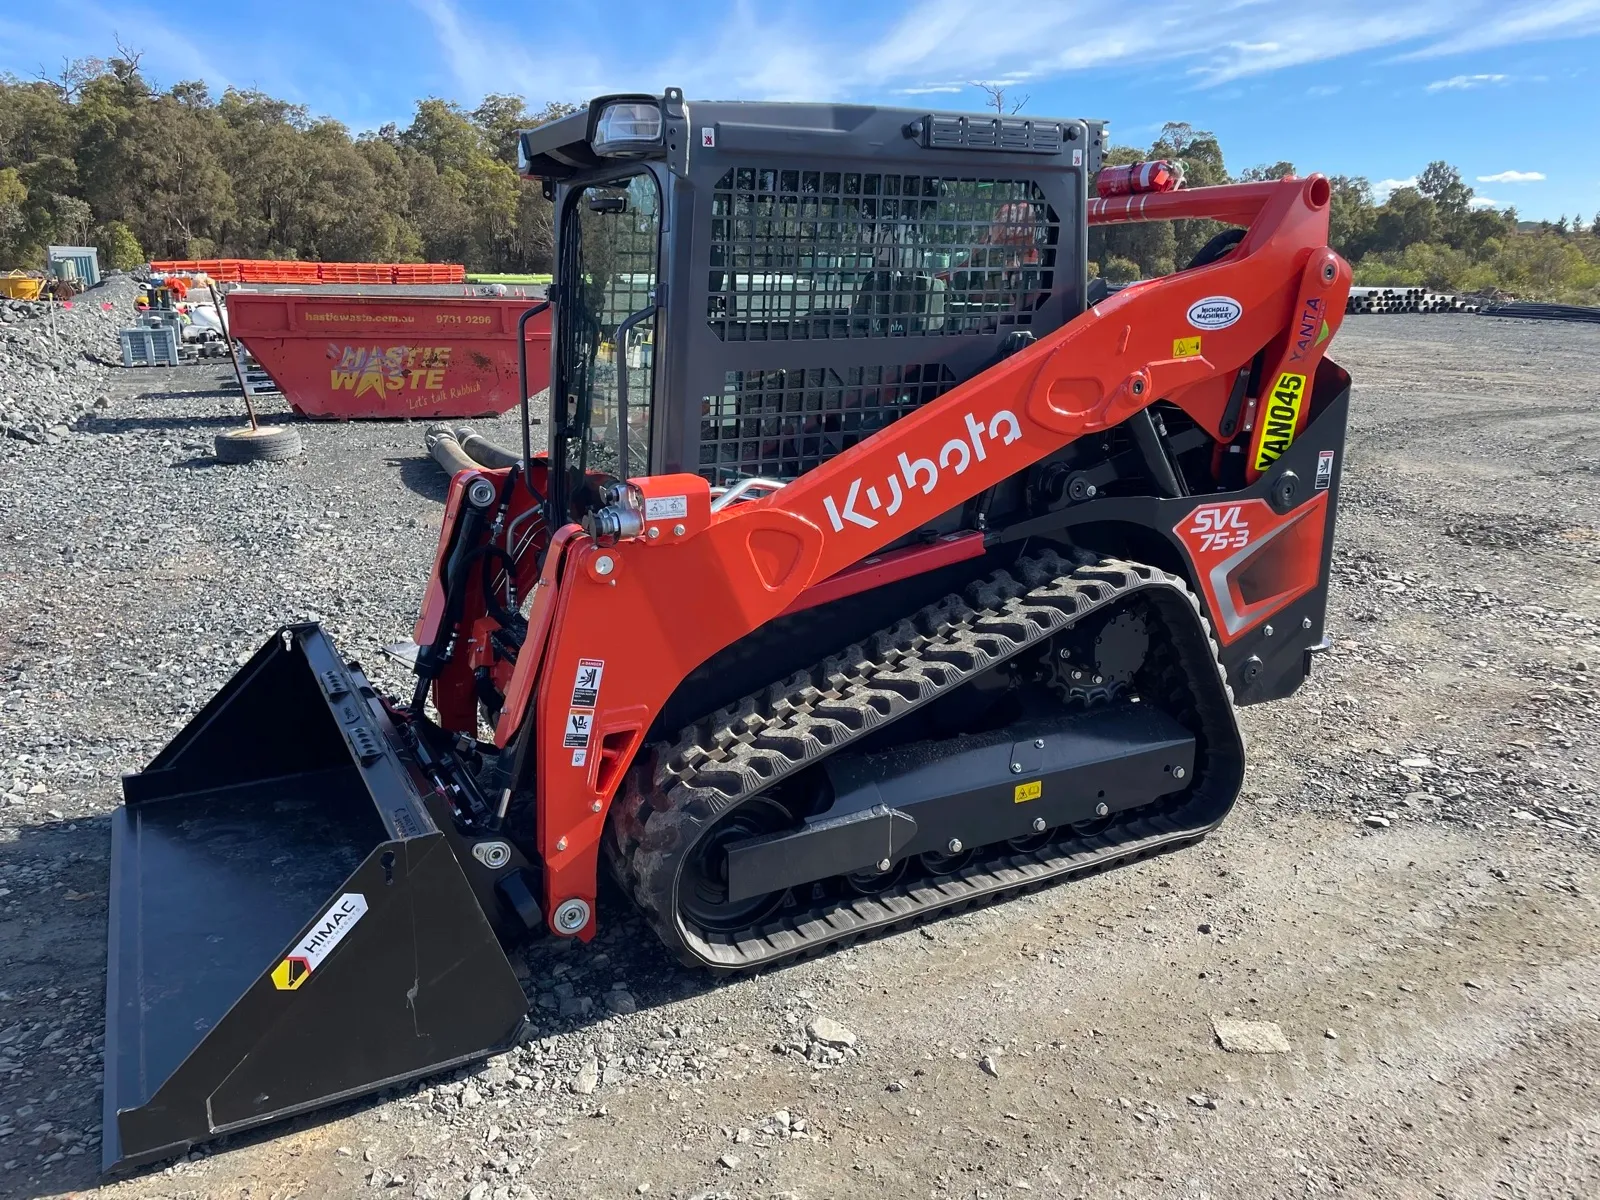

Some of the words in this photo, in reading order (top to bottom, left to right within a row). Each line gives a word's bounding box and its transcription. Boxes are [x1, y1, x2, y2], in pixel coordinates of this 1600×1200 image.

[305, 312, 415, 323] hastiewaste.com.au
[436, 315, 461, 324] 9731
[465, 315, 491, 324] 0296
[1197, 312, 1232, 320] MACHINERY
[1289, 298, 1320, 362] YANTA
[342, 346, 452, 367] HASTIE
[331, 369, 445, 398] WASTE
[1259, 375, 1302, 469] YAN045
[822, 410, 1022, 533] Kubota
[1190, 506, 1248, 533] SVL
[1199, 529, 1249, 552] 75-3
[304, 900, 356, 953] HIMAC
